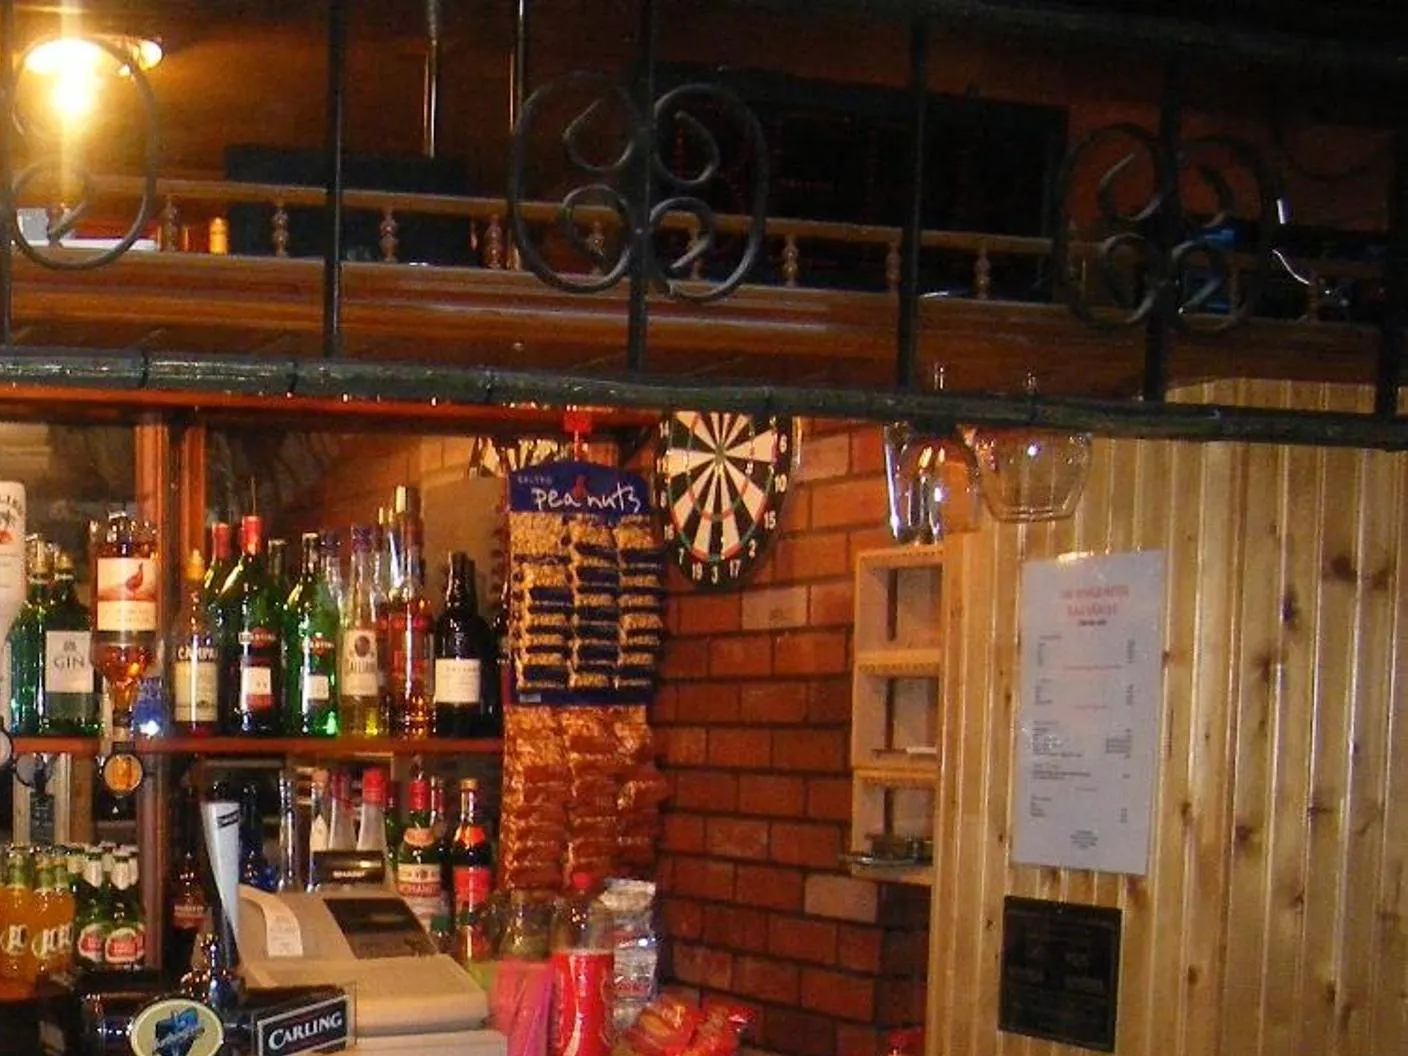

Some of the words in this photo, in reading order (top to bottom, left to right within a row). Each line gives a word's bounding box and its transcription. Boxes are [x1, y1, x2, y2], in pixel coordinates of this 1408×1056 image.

[774, 473, 788, 493] 10
[763, 510, 777, 530] 15
[710, 565, 719, 584] 3
[729, 558, 741, 579] 17
[54, 655, 85, 670] GIN
[267, 1011, 343, 1051] CARLING
